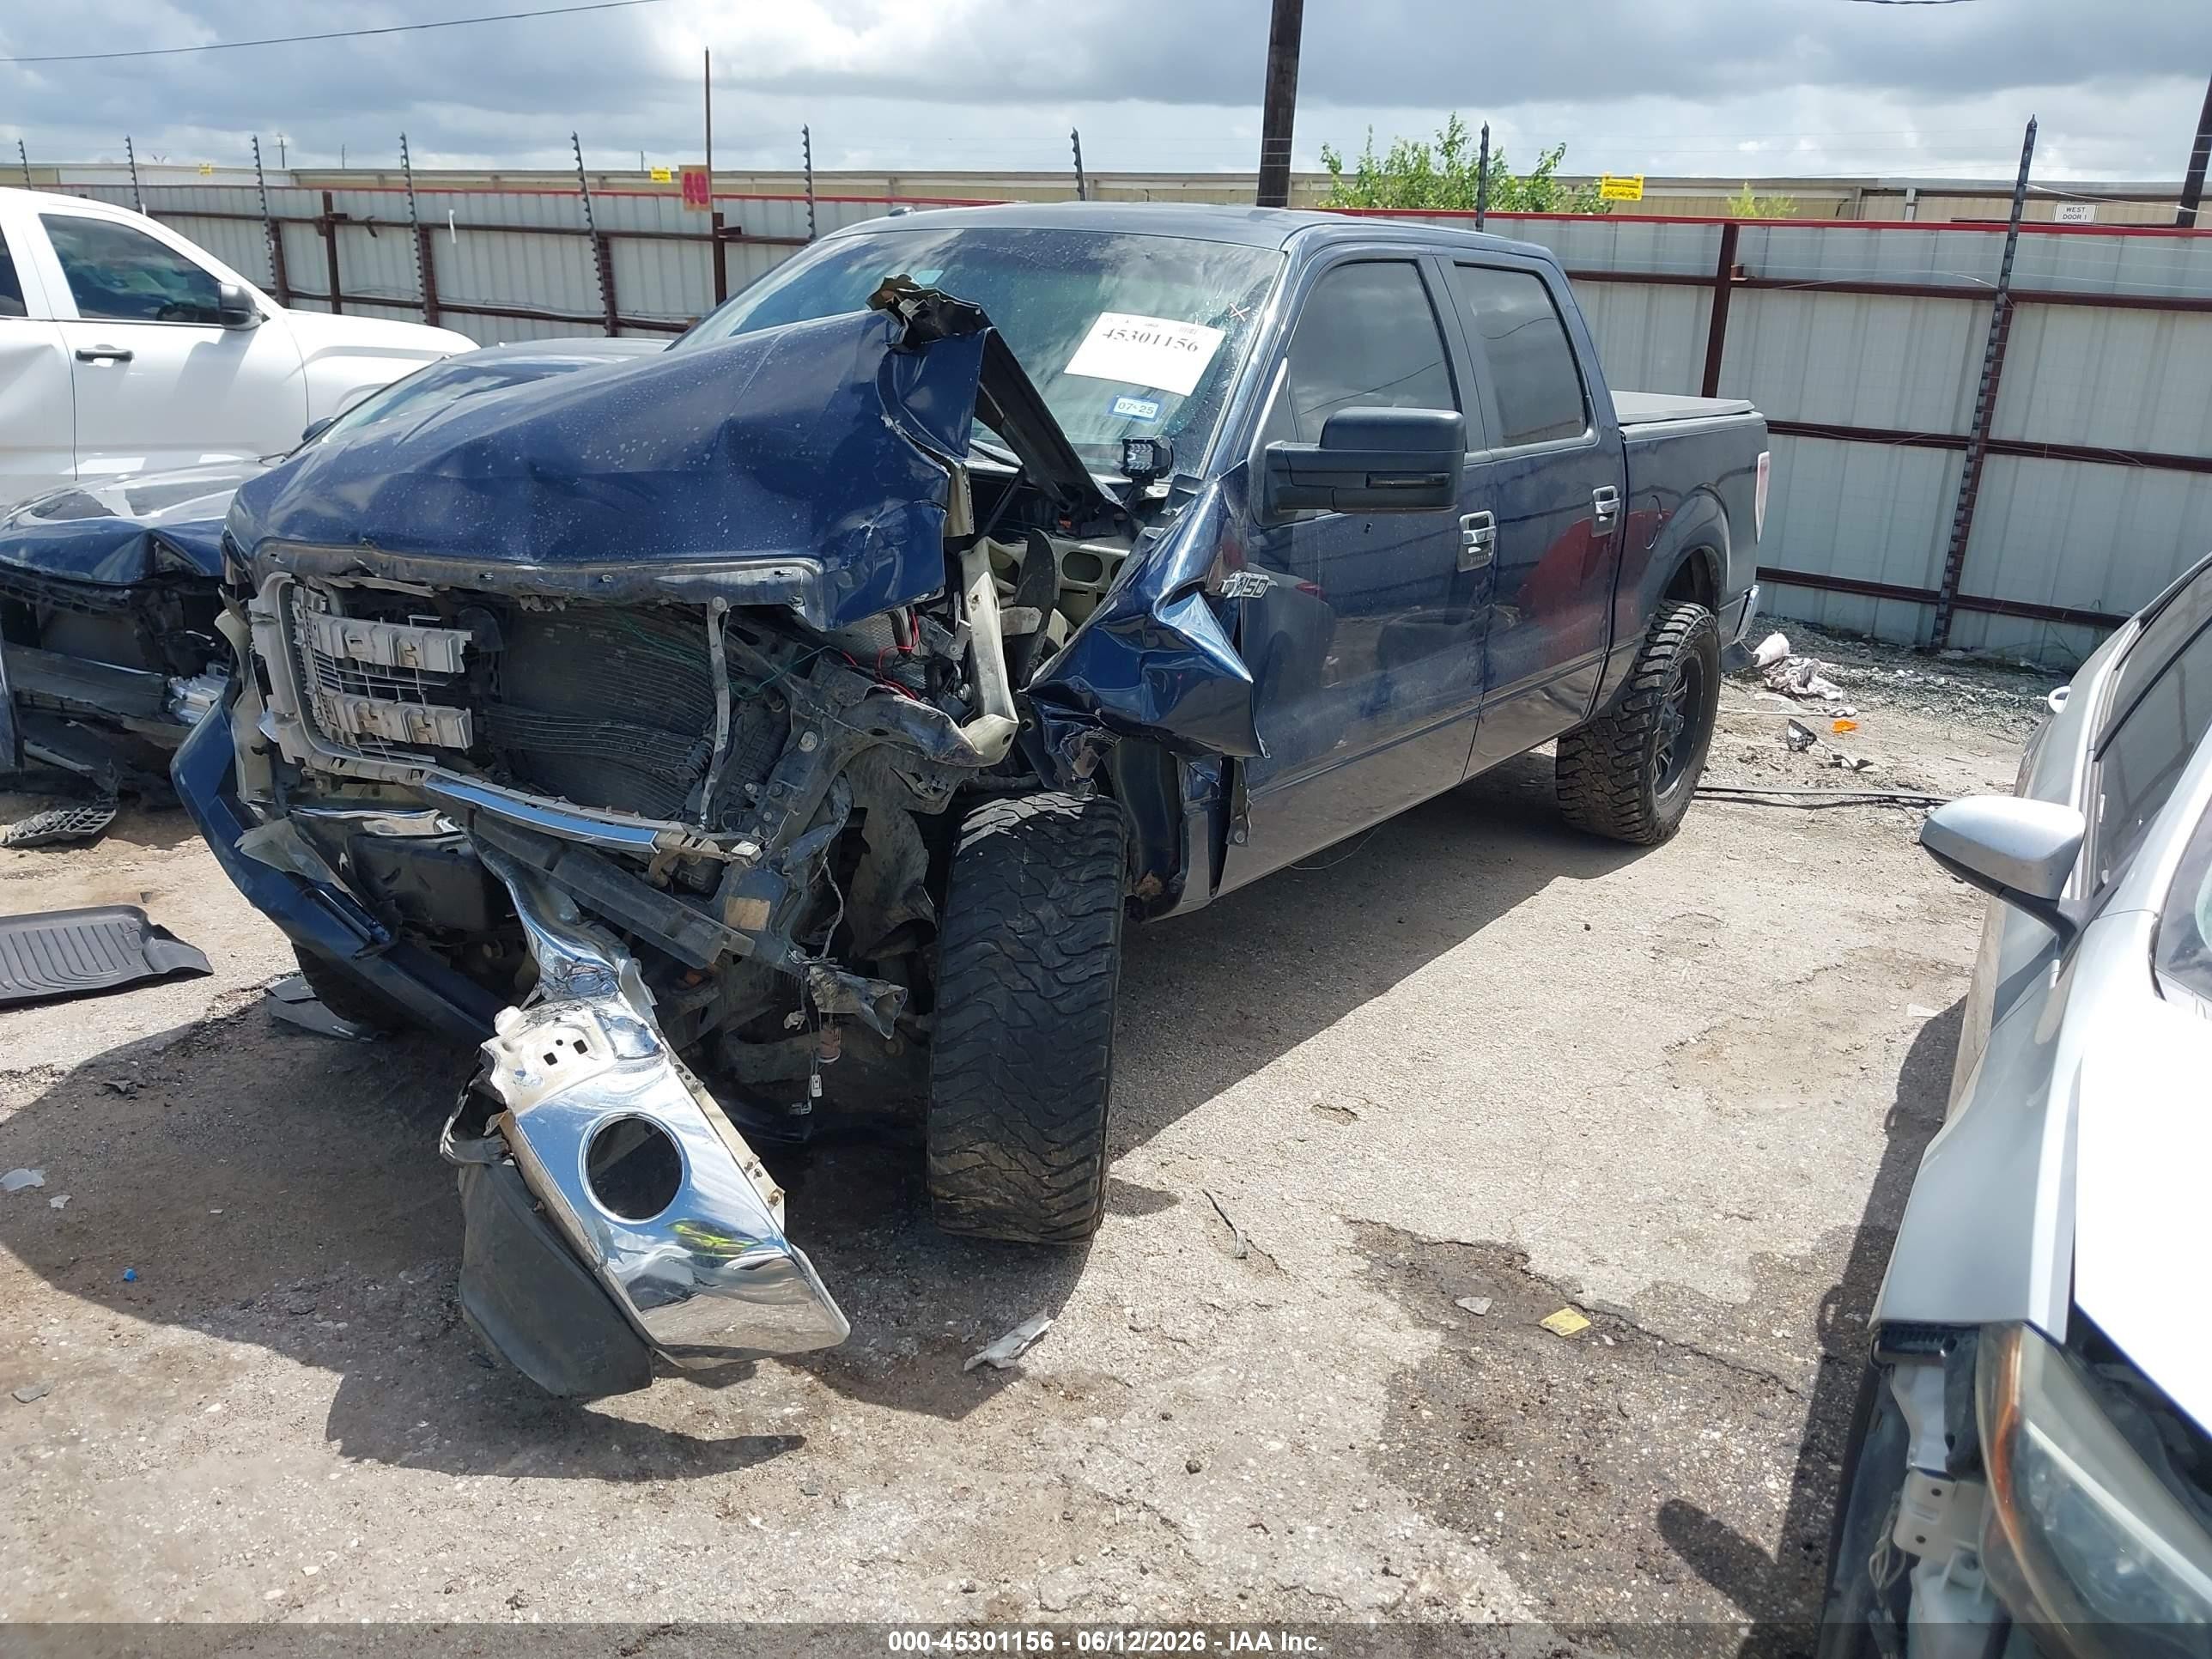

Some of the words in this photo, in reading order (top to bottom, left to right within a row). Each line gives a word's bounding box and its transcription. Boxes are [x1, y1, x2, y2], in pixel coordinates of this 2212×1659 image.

[1103, 328, 1199, 353] 45301156
[1118, 402, 1133, 410] 07
[1139, 405, 1154, 415] 25
